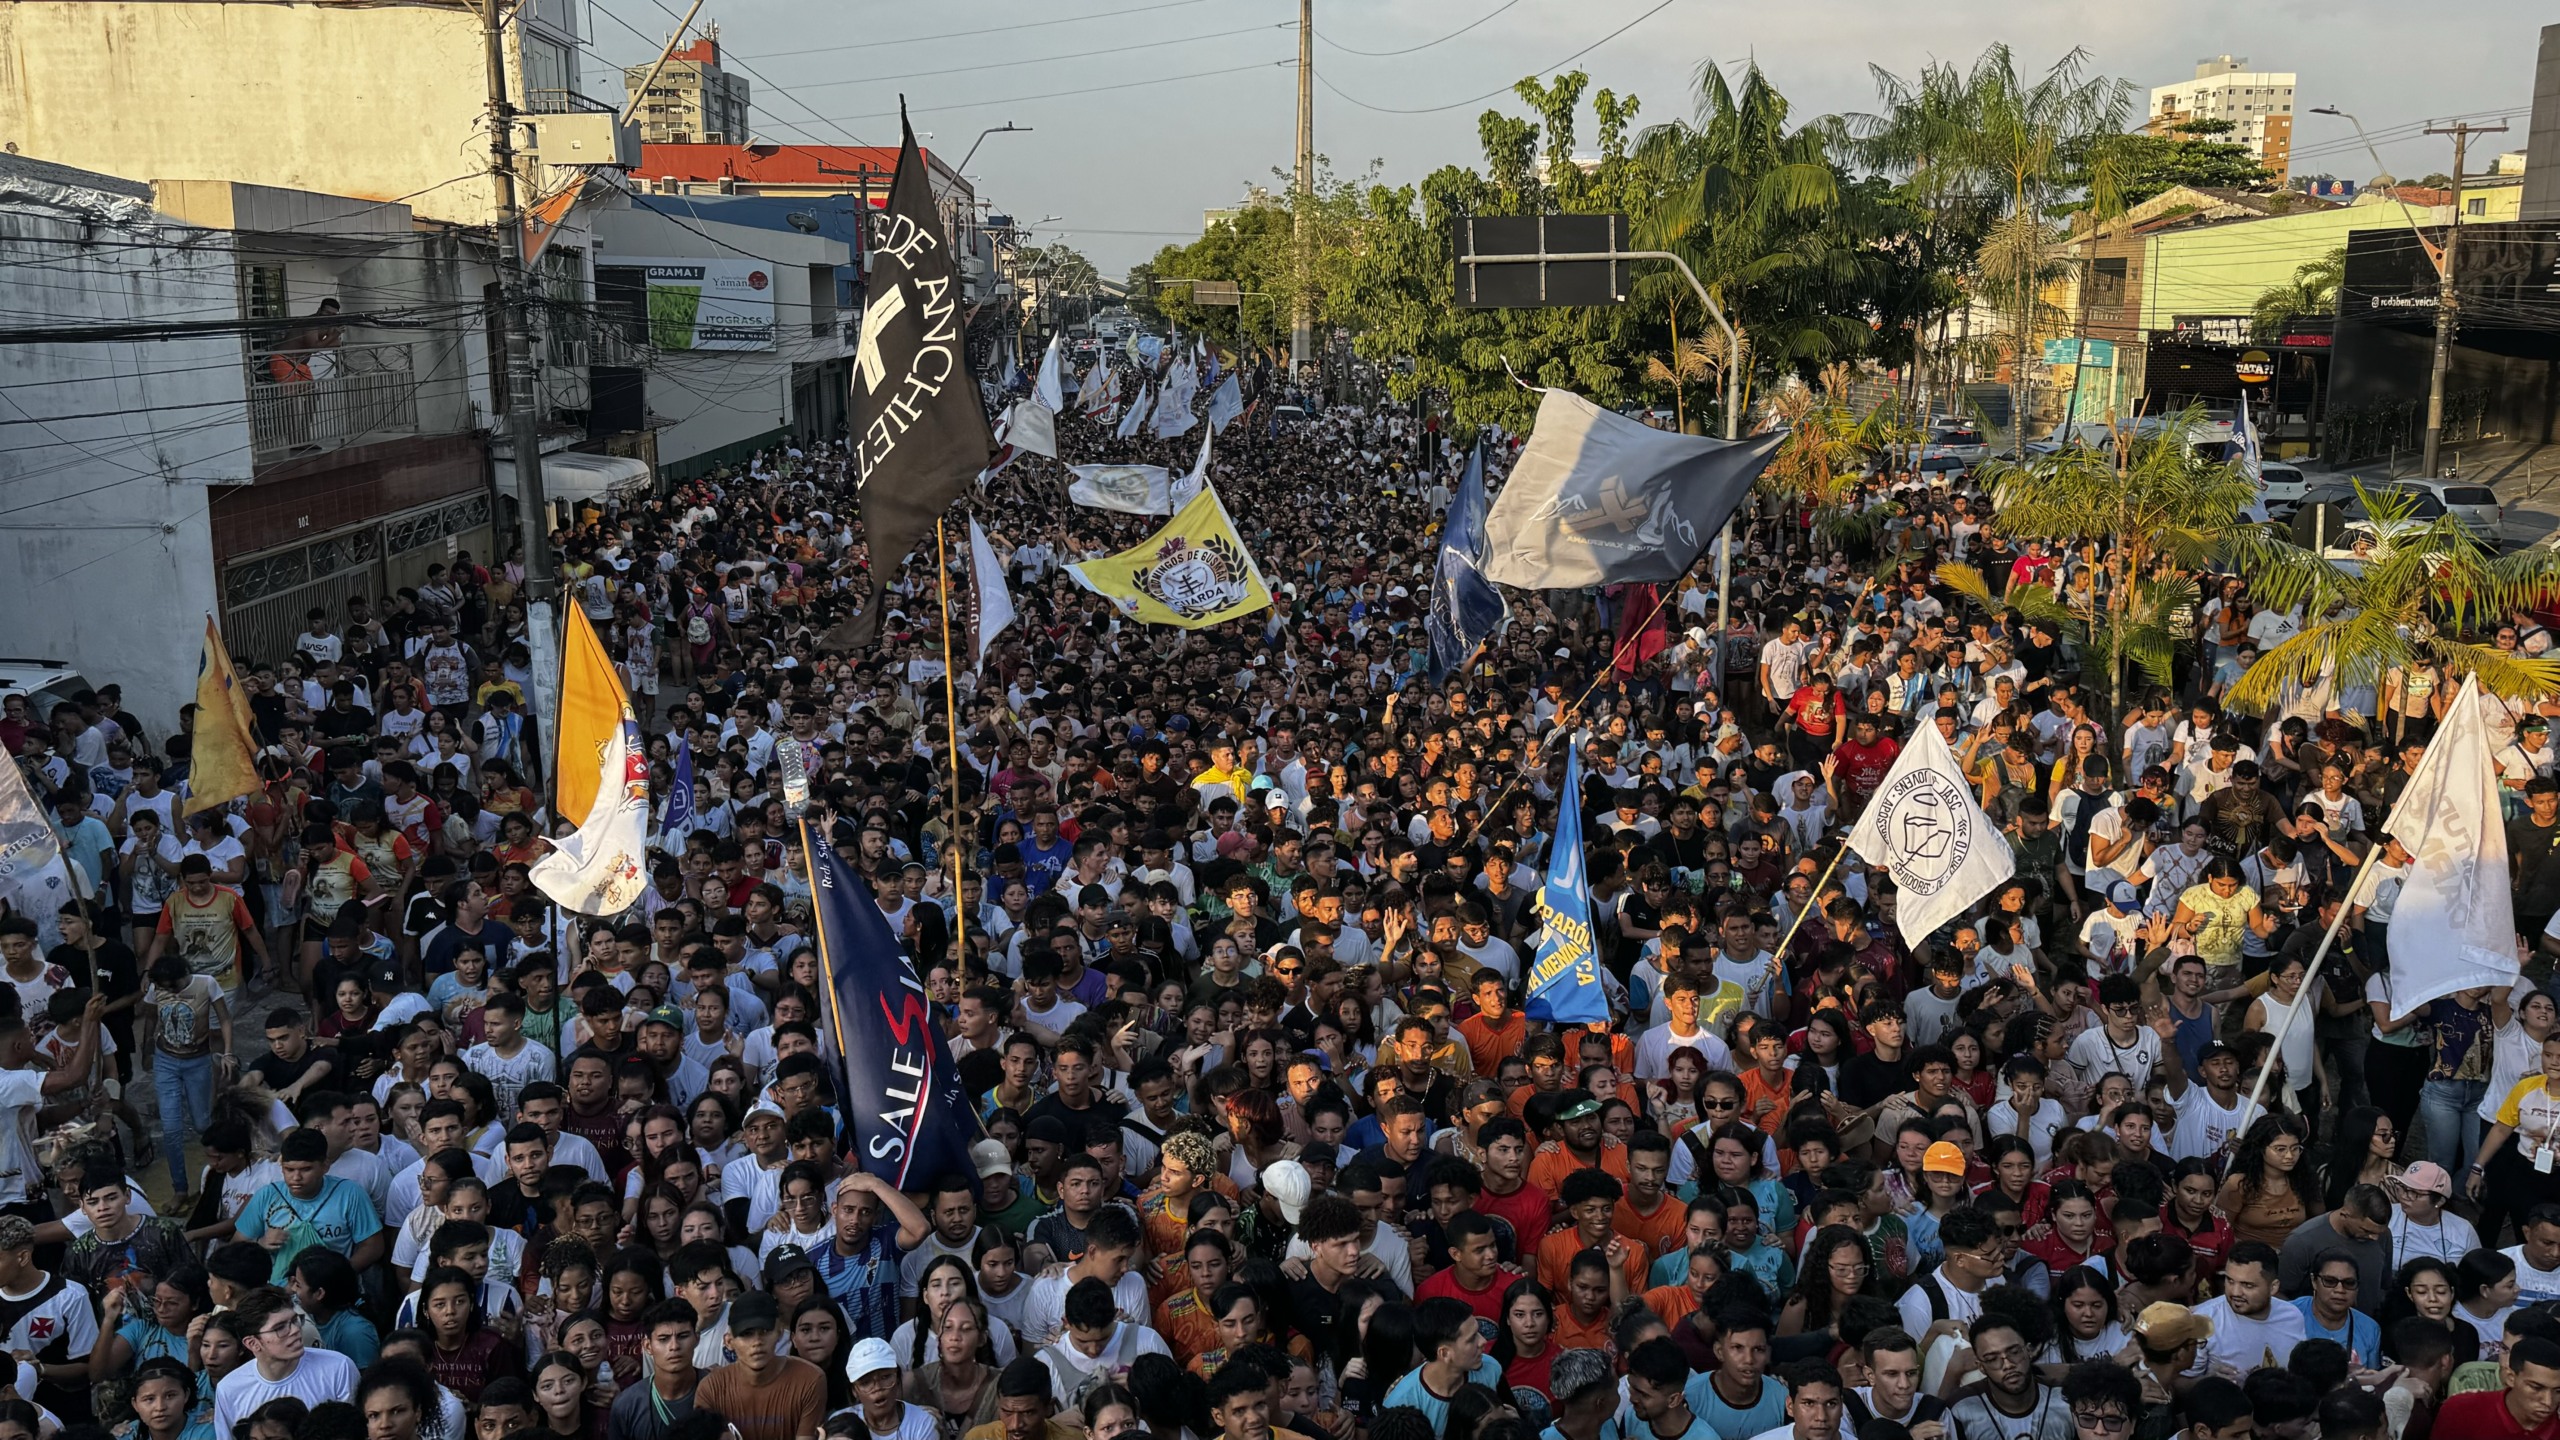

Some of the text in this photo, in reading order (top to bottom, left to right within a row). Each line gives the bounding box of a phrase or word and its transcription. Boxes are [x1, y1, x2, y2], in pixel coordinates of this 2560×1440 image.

[650, 267, 692, 277] GRAMA
[705, 315, 763, 325] ITOGRASS
[303, 642, 329, 653] NASA
[1940, 784, 1963, 812] JASC
